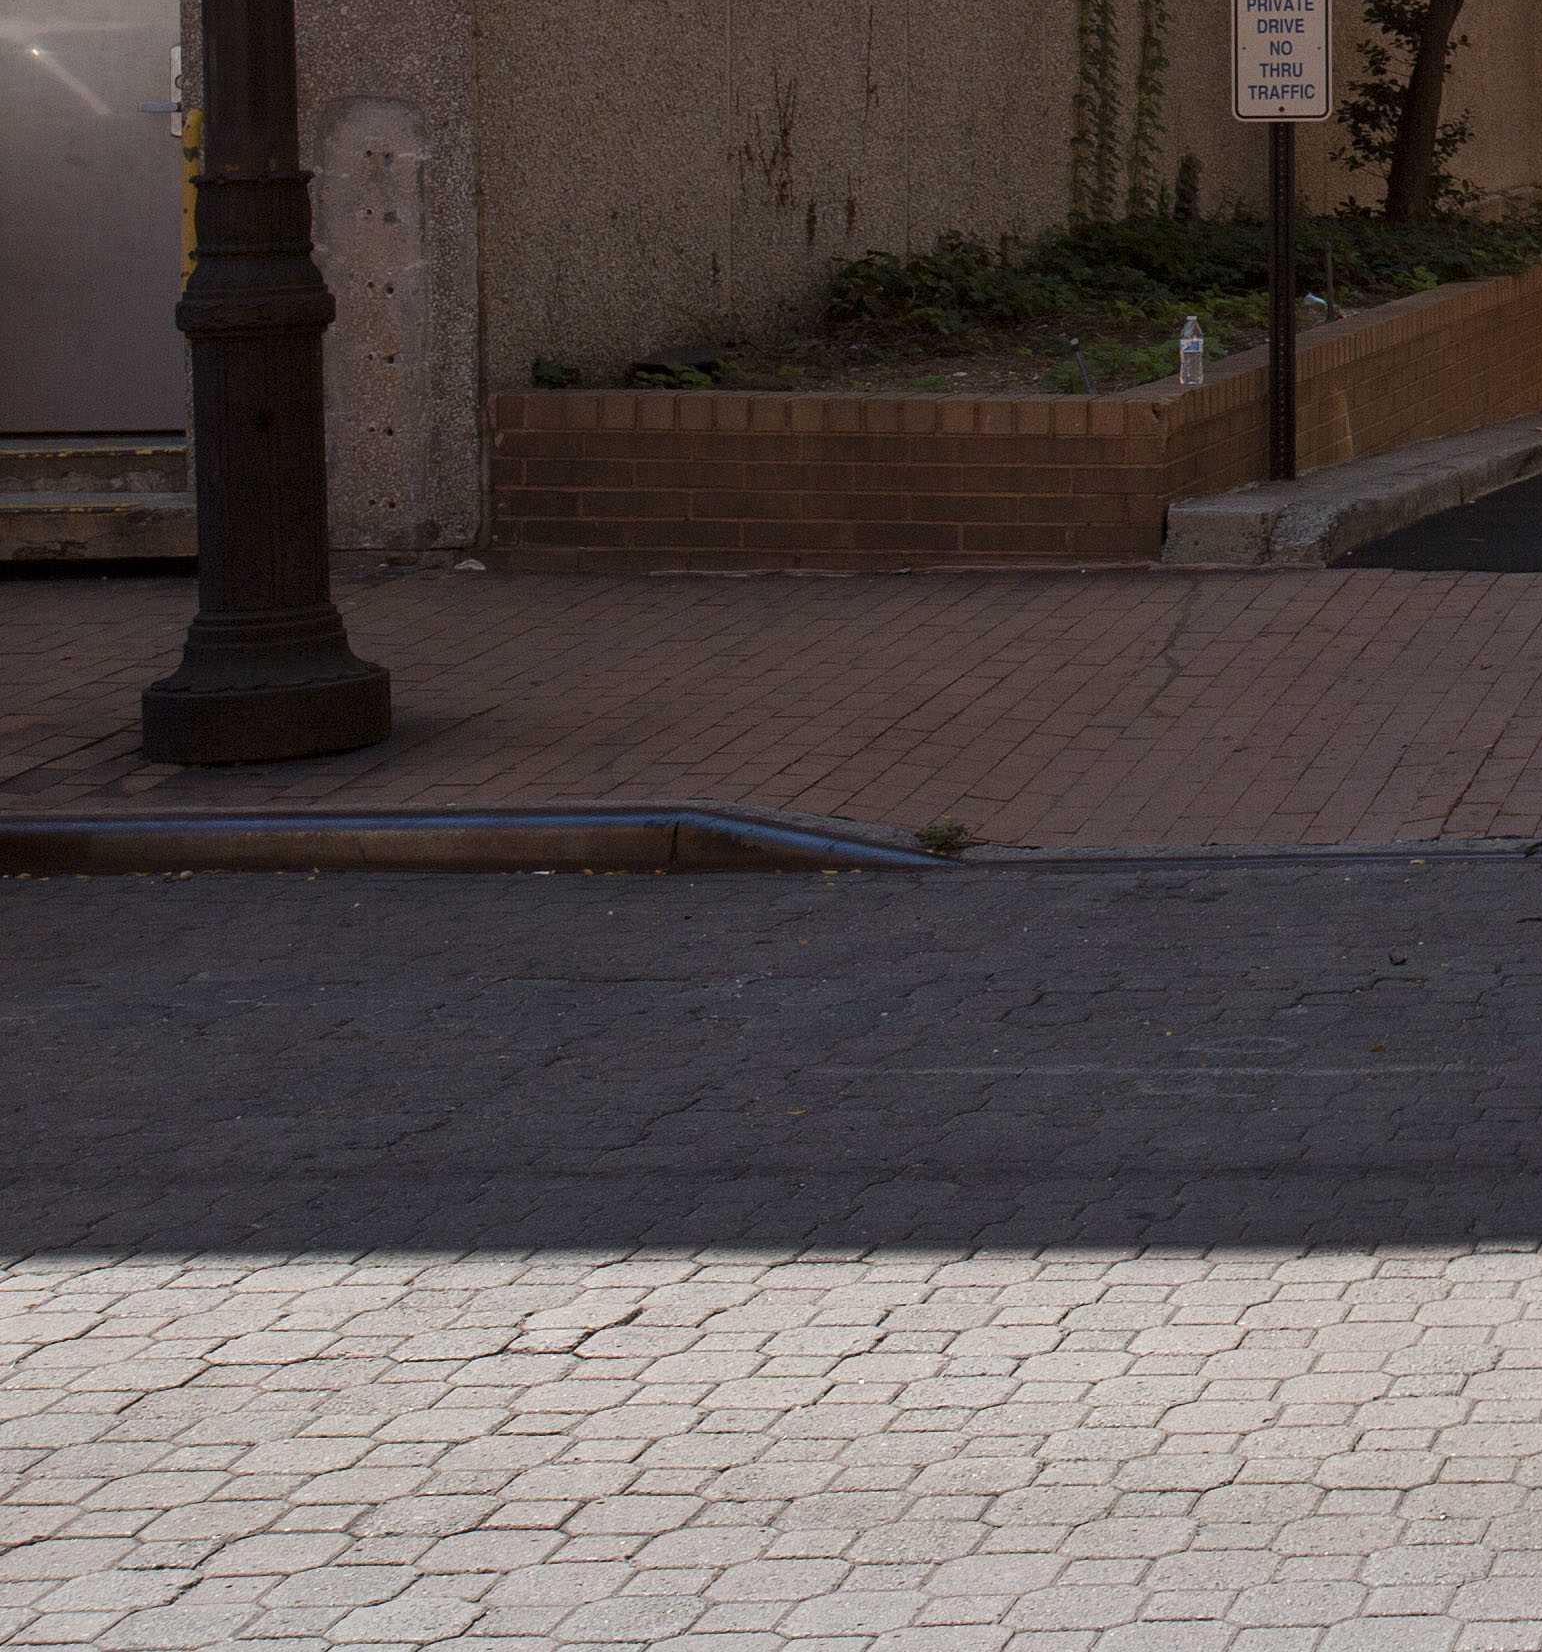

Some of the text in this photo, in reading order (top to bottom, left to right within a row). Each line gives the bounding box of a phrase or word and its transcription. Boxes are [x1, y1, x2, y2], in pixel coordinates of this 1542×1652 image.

[1257, 19, 1304, 34] DRIVE
[1269, 40, 1293, 56] NO
[1259, 62, 1303, 78] THRU
[1248, 85, 1316, 100] TRAFFIC
